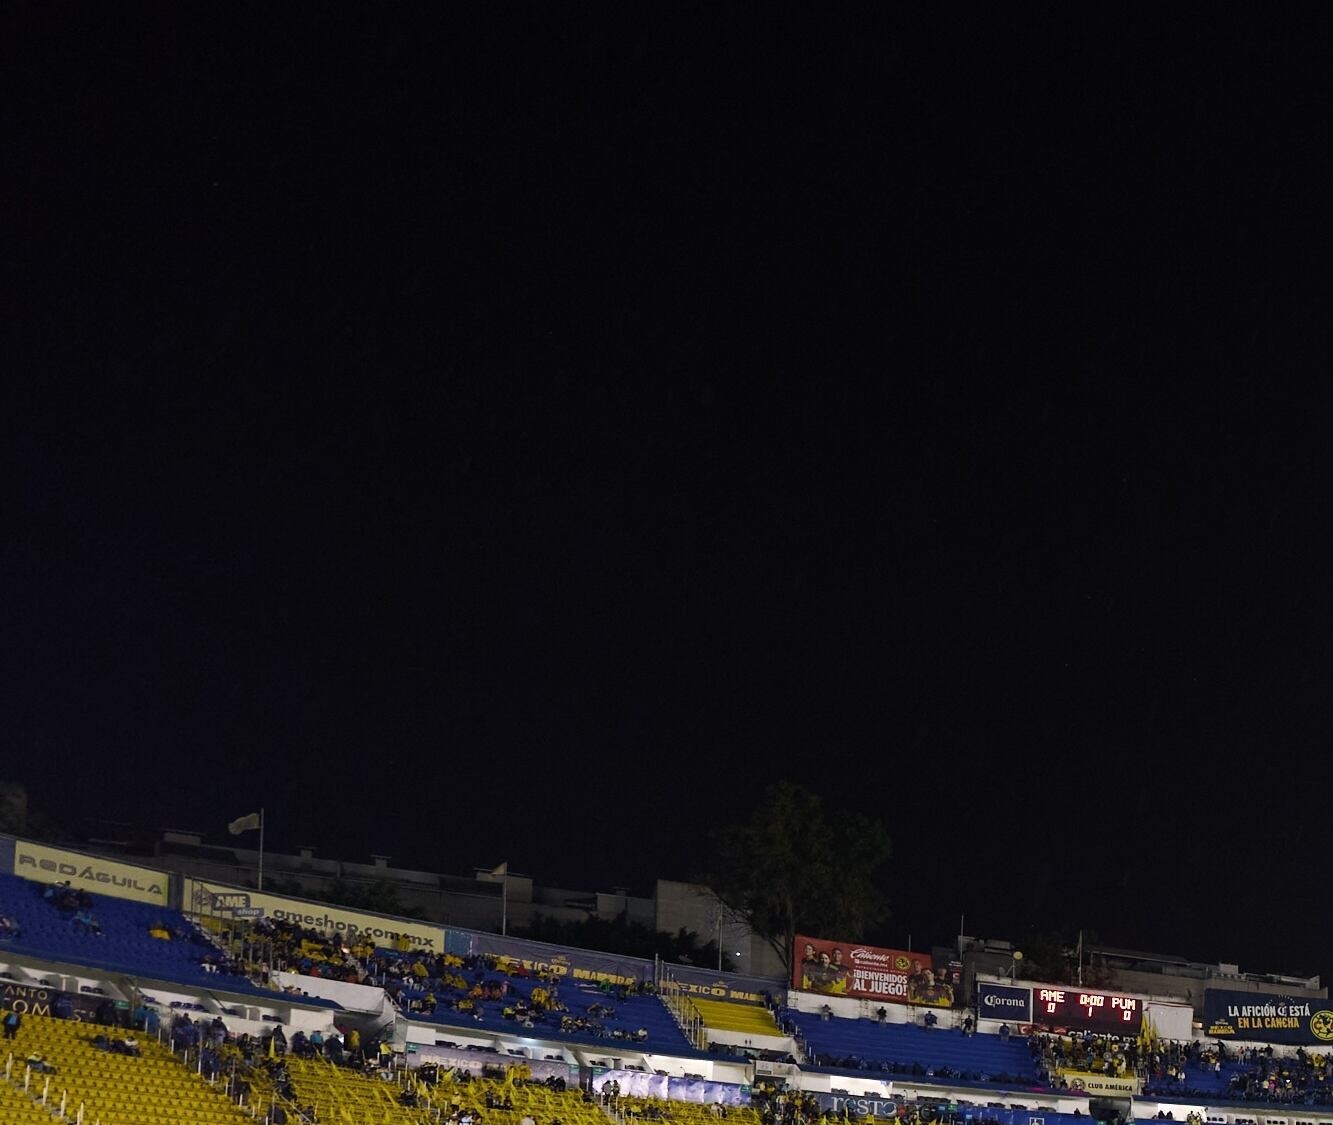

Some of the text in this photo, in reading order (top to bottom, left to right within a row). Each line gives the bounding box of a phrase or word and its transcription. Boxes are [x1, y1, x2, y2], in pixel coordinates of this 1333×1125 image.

[215, 895, 247, 908] AME
[273, 908, 434, 948] ameshop.commx
[850, 949, 890, 962] Caliente
[854, 969, 908, 984] ¡BIENVENIDOS
[0, 983, 48, 1001] ANTO
[853, 979, 907, 996] AL JUEGO!
[984, 994, 1025, 1008] Corona
[1040, 989, 1136, 1011] AME 0:00 PUM
[1047, 1002, 1055, 1013] 0
[1123, 1010, 1131, 1021] 0
[1228, 1003, 1311, 1017] LA AFICIÓN ESTÁ
[1238, 1017, 1300, 1029] EN LA CANCHA
[1105, 1083, 1132, 1091] AMÉRICA
